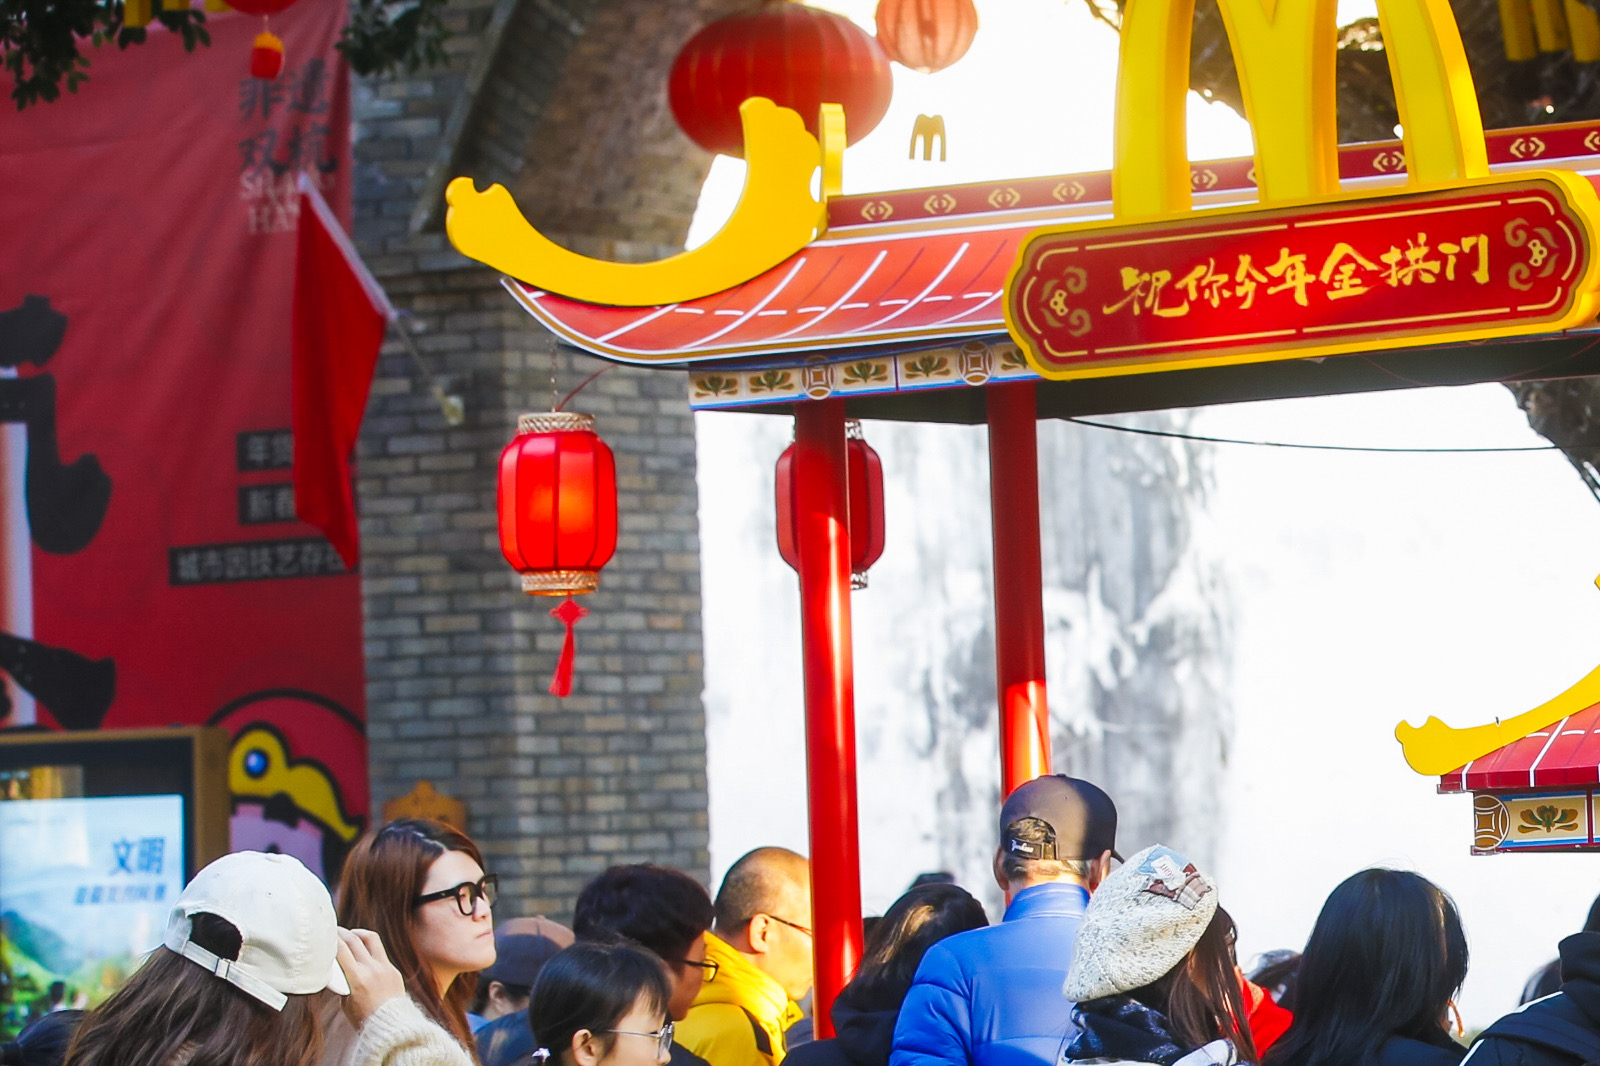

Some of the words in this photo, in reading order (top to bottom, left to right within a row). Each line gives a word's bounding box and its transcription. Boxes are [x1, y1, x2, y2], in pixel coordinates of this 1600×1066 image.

[1103, 232, 1490, 318] 祝你今年金拱门
[109, 836, 166, 876] 文明
